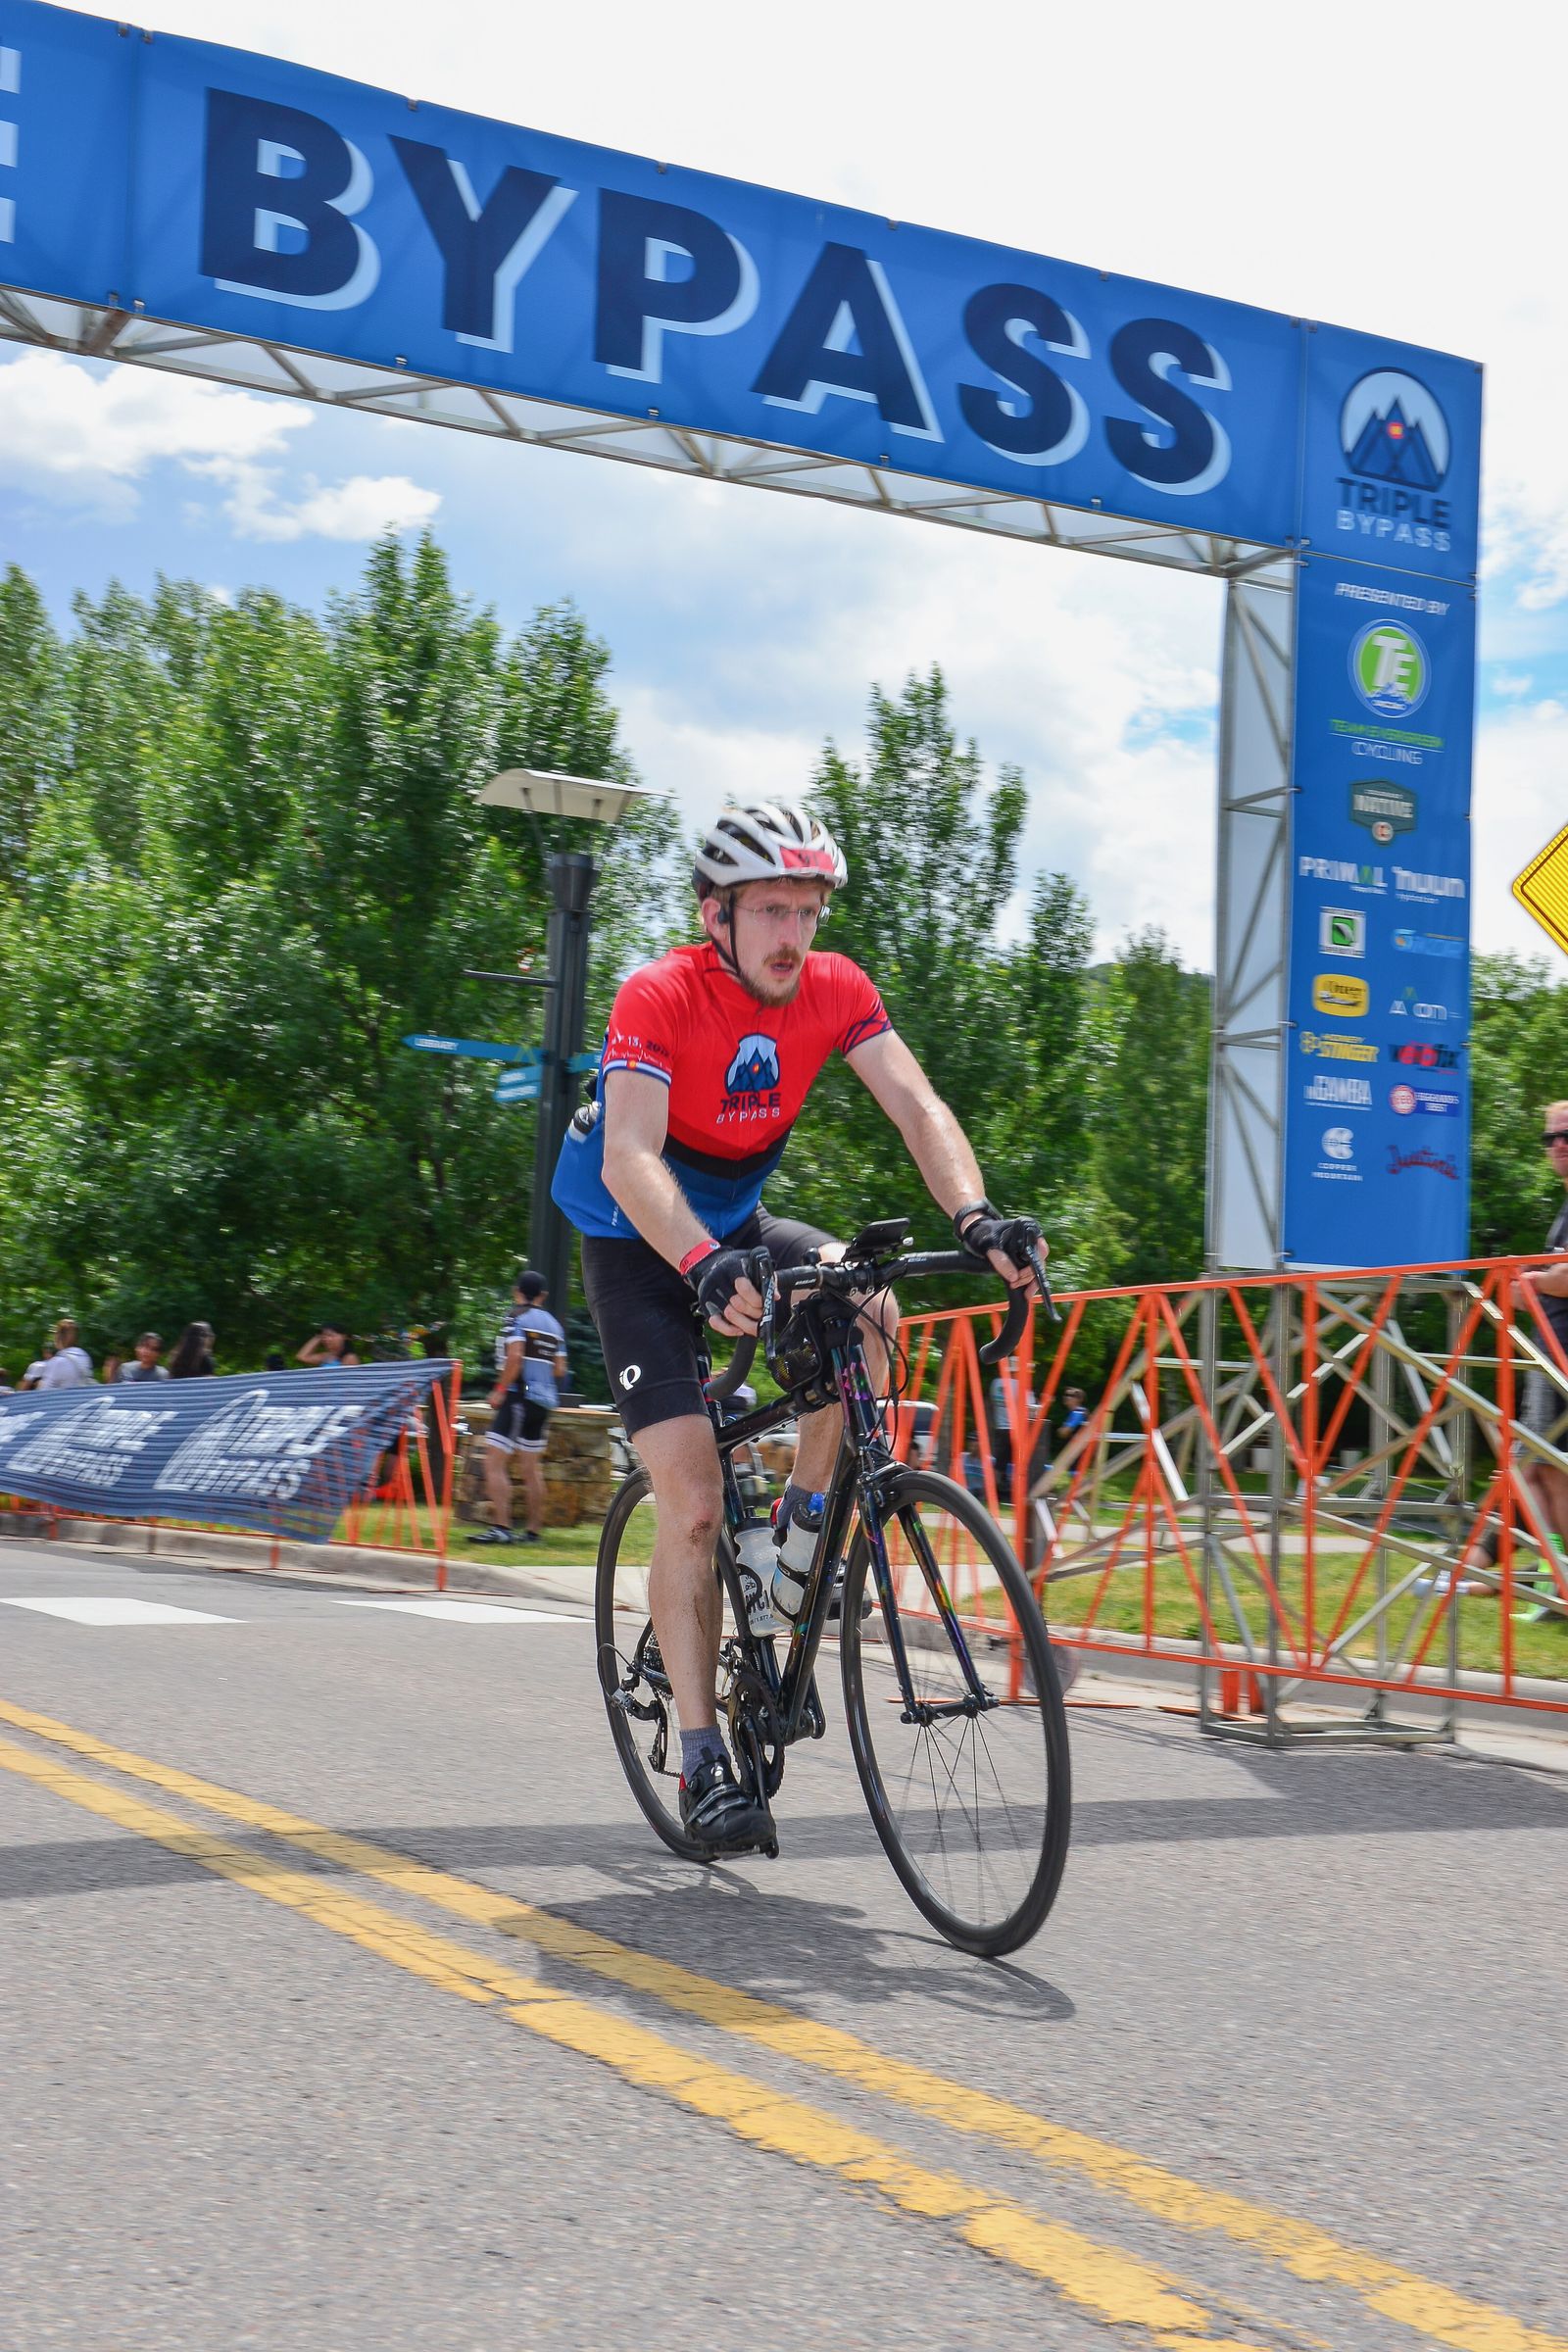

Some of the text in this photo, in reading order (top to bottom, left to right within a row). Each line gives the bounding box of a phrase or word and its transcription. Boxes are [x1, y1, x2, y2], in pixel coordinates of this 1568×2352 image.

[199, 86, 1232, 496] BYPASS
[1336, 477, 1451, 529] TRIPLE
[1336, 509, 1451, 552] BYPASS
[1334, 582, 1450, 616] PRESENTED BY
[1351, 741, 1423, 765] CYCLING
[1298, 856, 1389, 888] PRIMAL
[716, 1106, 781, 1124] BYPASS
[720, 1092, 782, 1114] TRIPLE
